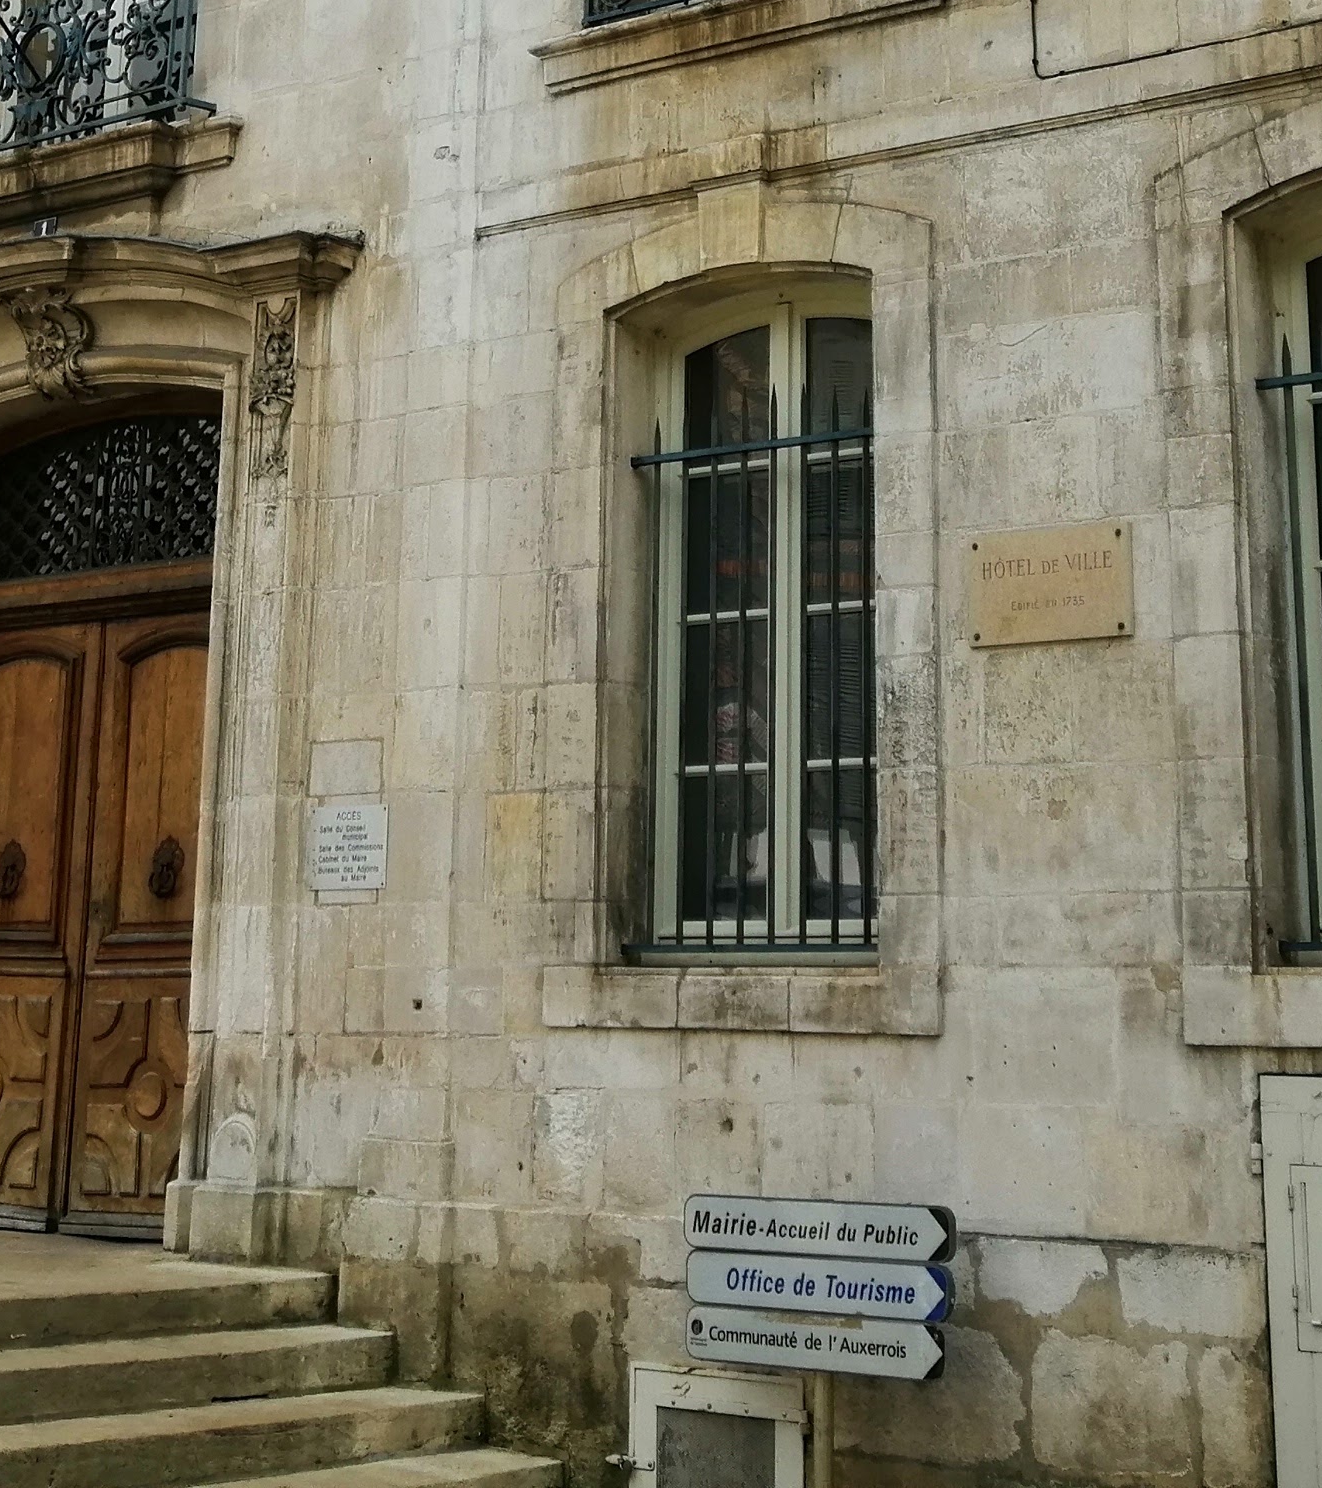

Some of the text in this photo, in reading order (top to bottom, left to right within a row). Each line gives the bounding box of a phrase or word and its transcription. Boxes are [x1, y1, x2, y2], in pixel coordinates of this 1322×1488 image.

[40, 221, 47, 237] 1
[982, 549, 1113, 580] HÔTEL DE VILLE
[1062, 595, 1085, 608] 1735
[837, 1220, 858, 1243] du
[863, 1223, 920, 1247] Public
[726, 1266, 917, 1306] Office de Tourisme
[708, 1324, 798, 1350] Communauté
[804, 1332, 822, 1352] de
